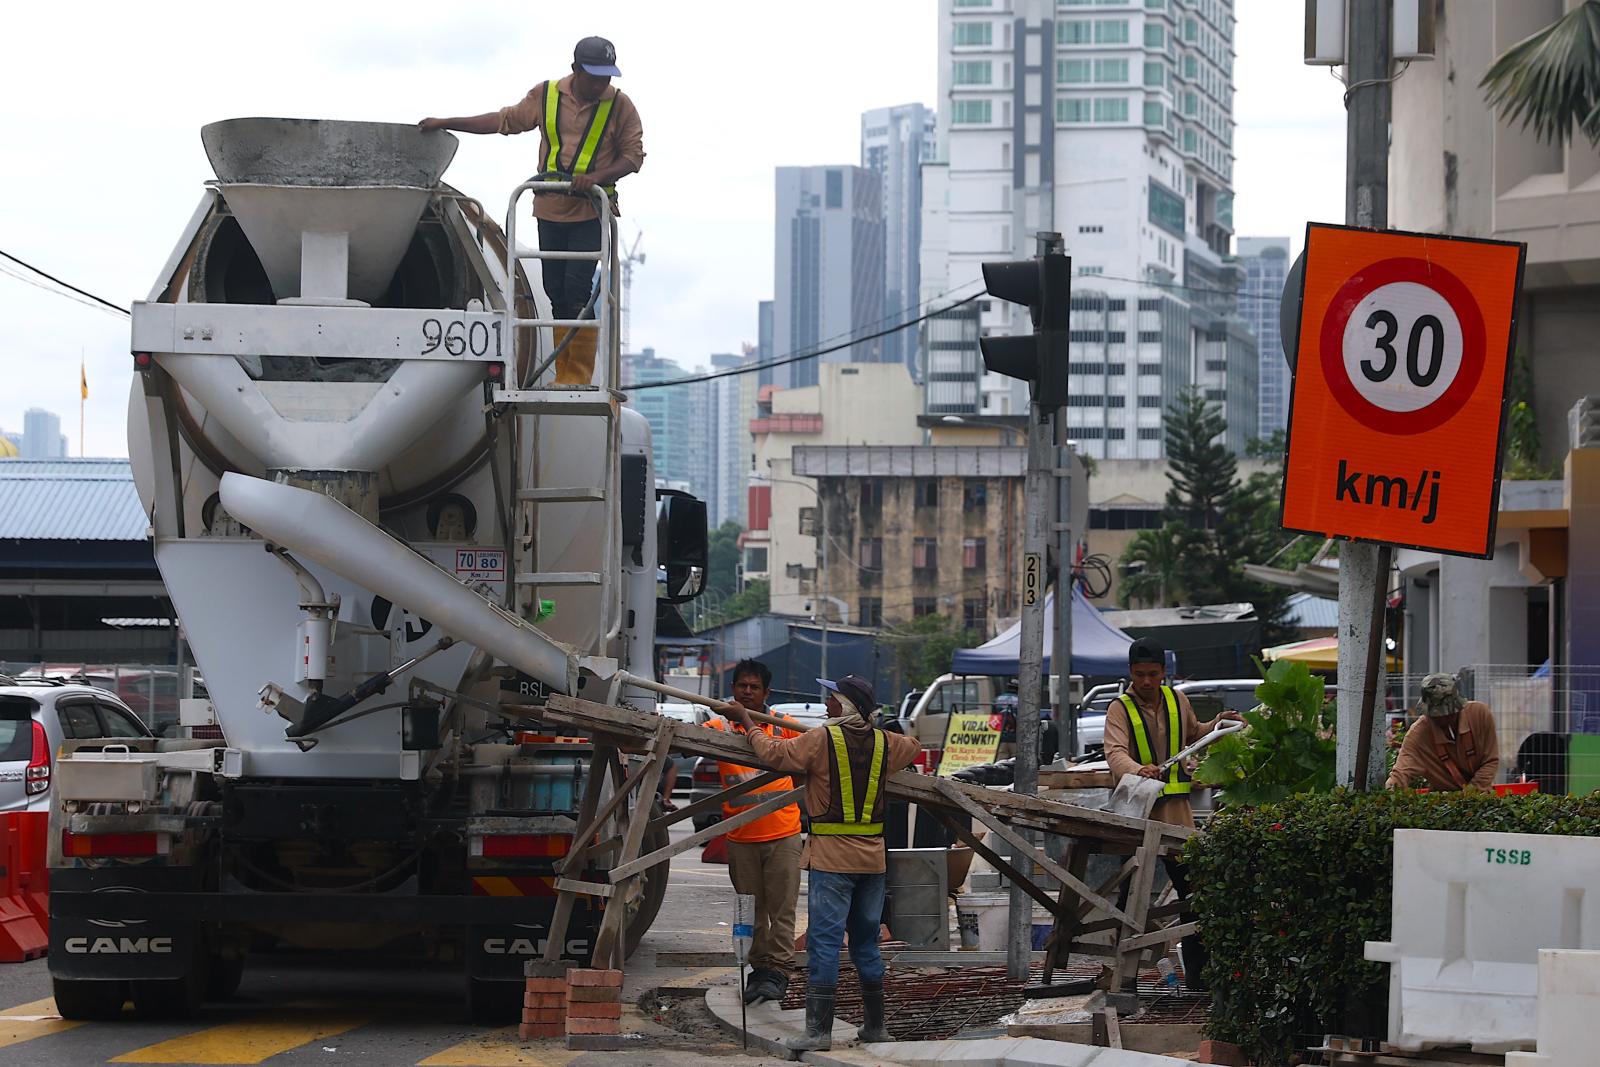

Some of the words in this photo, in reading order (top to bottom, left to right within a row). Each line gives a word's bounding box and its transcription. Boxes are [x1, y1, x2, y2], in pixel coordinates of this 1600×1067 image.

[421, 318, 503, 357] 9601
[1360, 310, 1445, 387] 30
[1335, 459, 1441, 524] km/j
[459, 553, 474, 568] 70
[480, 558, 498, 569] 80
[1027, 556, 1036, 605] 203
[962, 720, 989, 732] VIRAL
[950, 733, 997, 745] CHOWKIT
[1485, 848, 1531, 865] TSSB
[65, 937, 172, 954] CAMC
